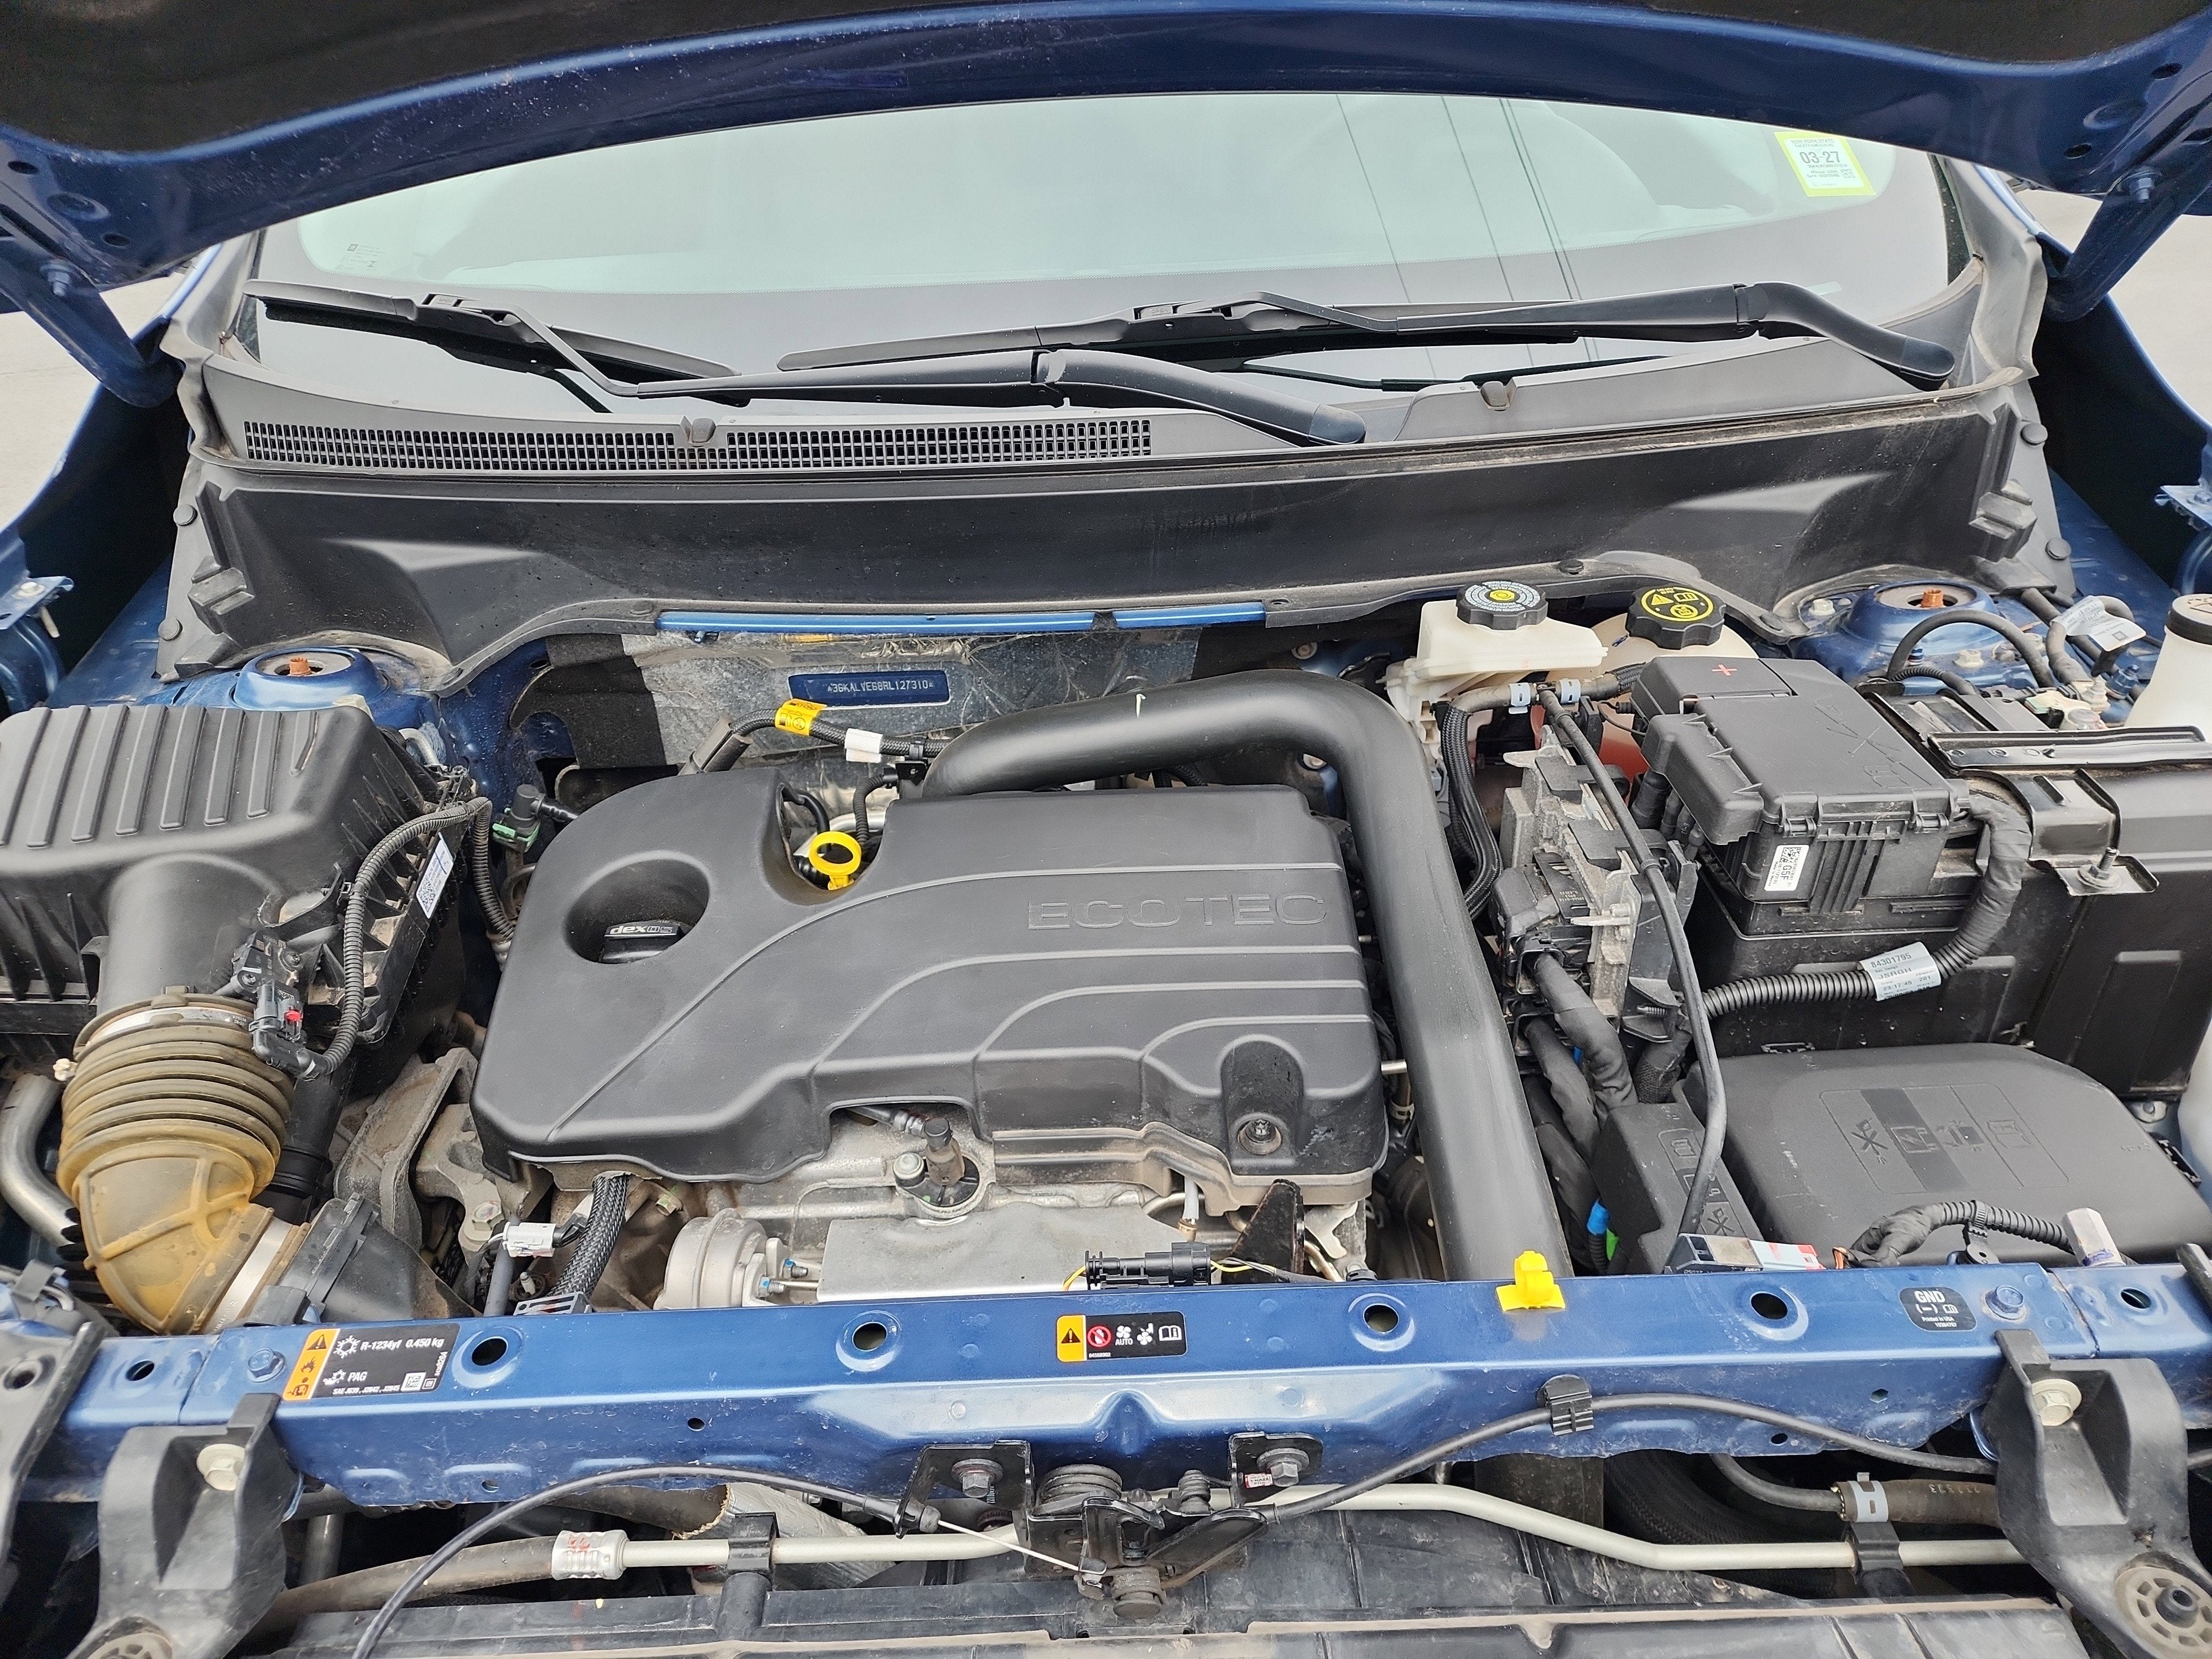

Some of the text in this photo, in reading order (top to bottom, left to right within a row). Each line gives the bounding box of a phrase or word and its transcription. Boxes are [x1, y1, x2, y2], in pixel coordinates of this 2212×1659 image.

[1799, 151, 1840, 163] 03-27
[1780, 864, 1792, 880] G5F
[1027, 894, 1327, 930] ECOTEC
[610, 925, 673, 935] dexos
[1871, 952, 1912, 968] 84301795
[1914, 1290, 1945, 1303] GND
[360, 1338, 445, 1350] R-1234yf 0.450 kg
[347, 1371, 368, 1383] PAG
